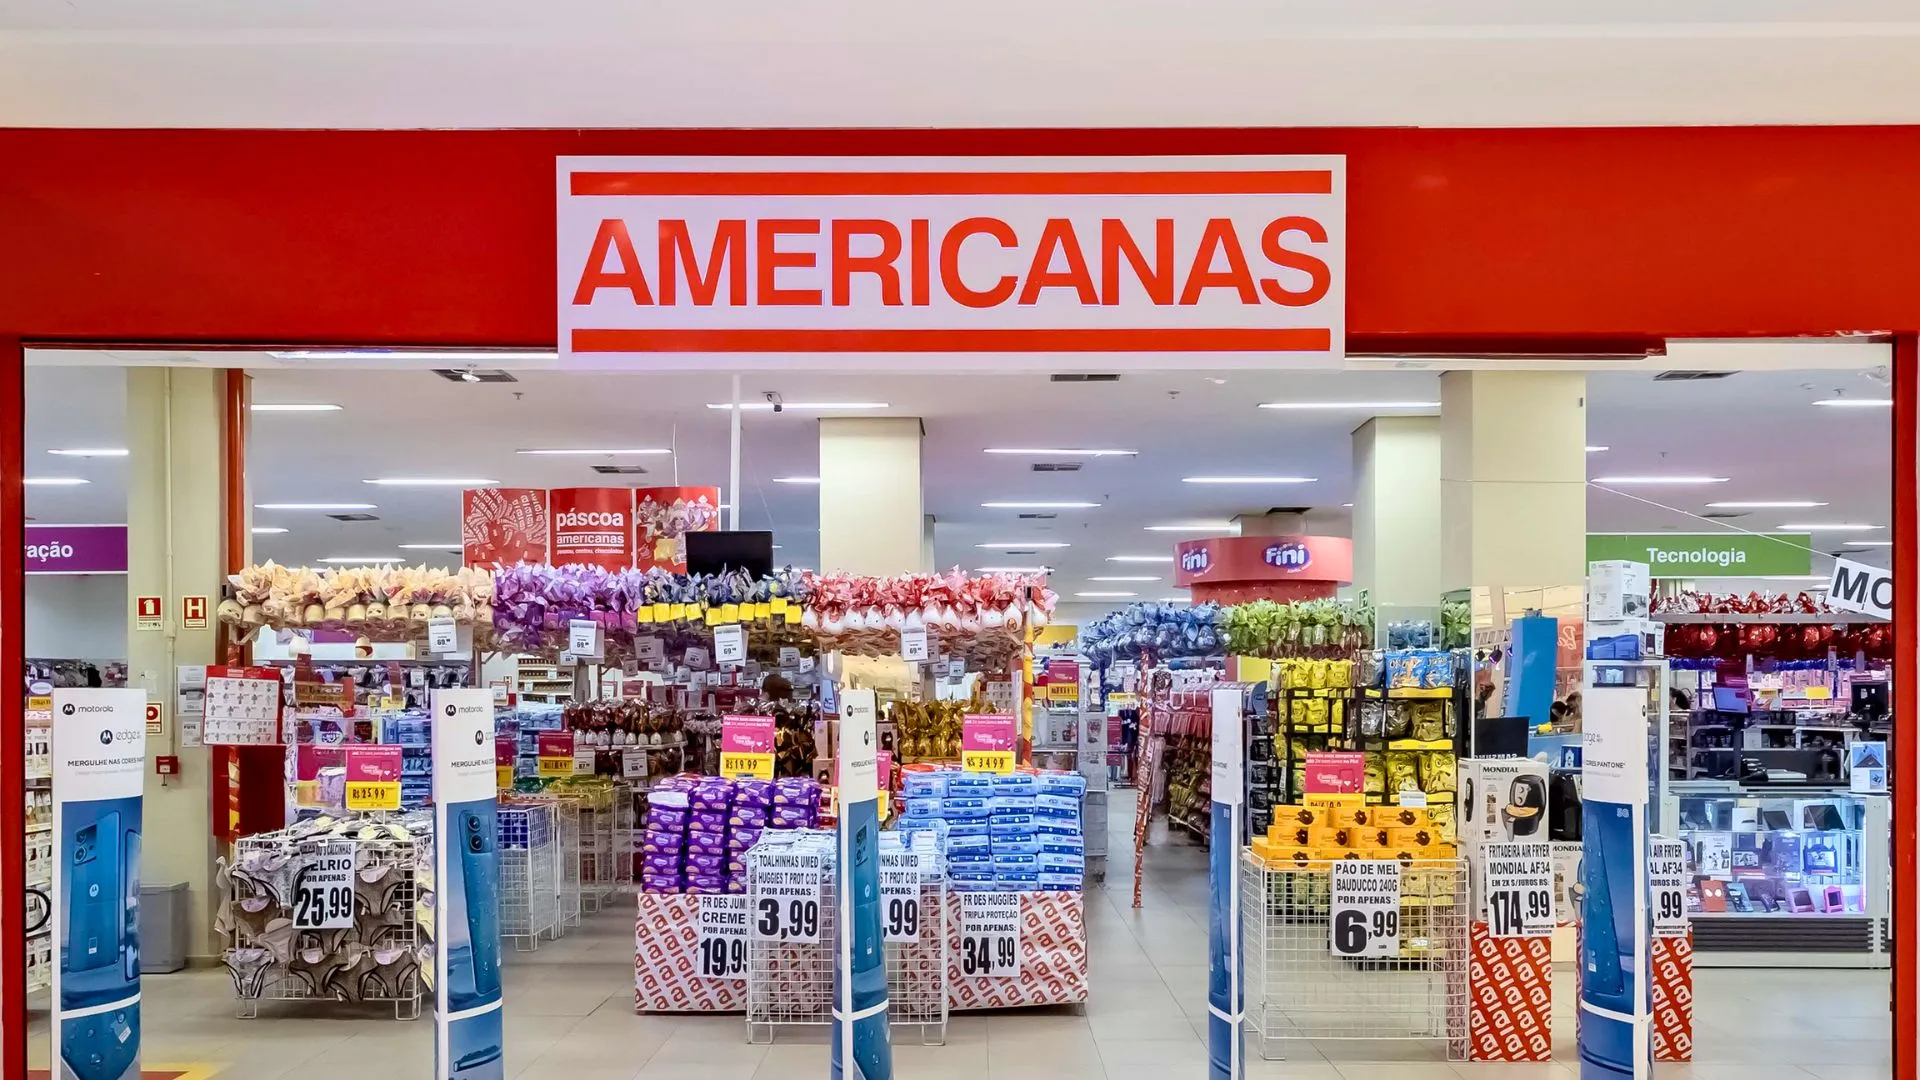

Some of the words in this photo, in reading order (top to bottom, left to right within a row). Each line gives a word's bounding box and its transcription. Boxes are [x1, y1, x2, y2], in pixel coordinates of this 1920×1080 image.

[571, 216, 1331, 308] AMERICANAS
[556, 508, 624, 531] páscoa
[556, 535, 624, 544] americanas
[1182, 548, 1208, 571] Fini
[1266, 544, 1305, 566] Fini
[1646, 547, 1746, 567] Tecnologia
[78, 705, 113, 713] motorola
[116, 730, 136, 744] edge
[1489, 845, 1520, 858] FRITADEIRA
[1522, 844, 1531, 858] AIR
[1532, 844, 1550, 857] FRYER
[1654, 845, 1663, 858] AIR
[1664, 845, 1682, 858] FRYER
[310, 859, 352, 871] ELRIO
[760, 855, 799, 868] TOALHINHAS
[801, 856, 818, 868] UMED
[901, 855, 918, 868] UMED
[1490, 862, 1527, 874] MONDIAL
[1530, 862, 1550, 874] AF34
[1662, 862, 1682, 874] AF34
[1336, 862, 1357, 874] PÃO
[1360, 864, 1374, 874] DE
[1377, 864, 1398, 875] MEL
[318, 874, 346, 882] APENAS
[758, 872, 784, 885] HUGGIES
[785, 873, 789, 884] T
[790, 873, 804, 885] PROT
[890, 872, 904, 884] PROT
[761, 887, 779, 895] POR
[780, 888, 811, 896] APENAS
[1336, 879, 1377, 892] BAUDUCCO
[1380, 879, 1397, 892] 240G
[296, 886, 352, 926] 25,99
[703, 897, 711, 908] FR
[714, 898, 728, 909] DES
[730, 898, 746, 910] JUM
[964, 894, 972, 906] FR
[974, 894, 986, 905] DES
[988, 894, 1017, 906] HUGGIES
[1358, 896, 1391, 904] APENAS
[702, 912, 746, 924] CREME
[758, 898, 818, 940] 3,99
[986, 910, 1018, 920] PROTEÇÃO
[1490, 890, 1550, 935] 174,99
[1335, 910, 1397, 954] 6,99
[963, 937, 1015, 975] 34,99
